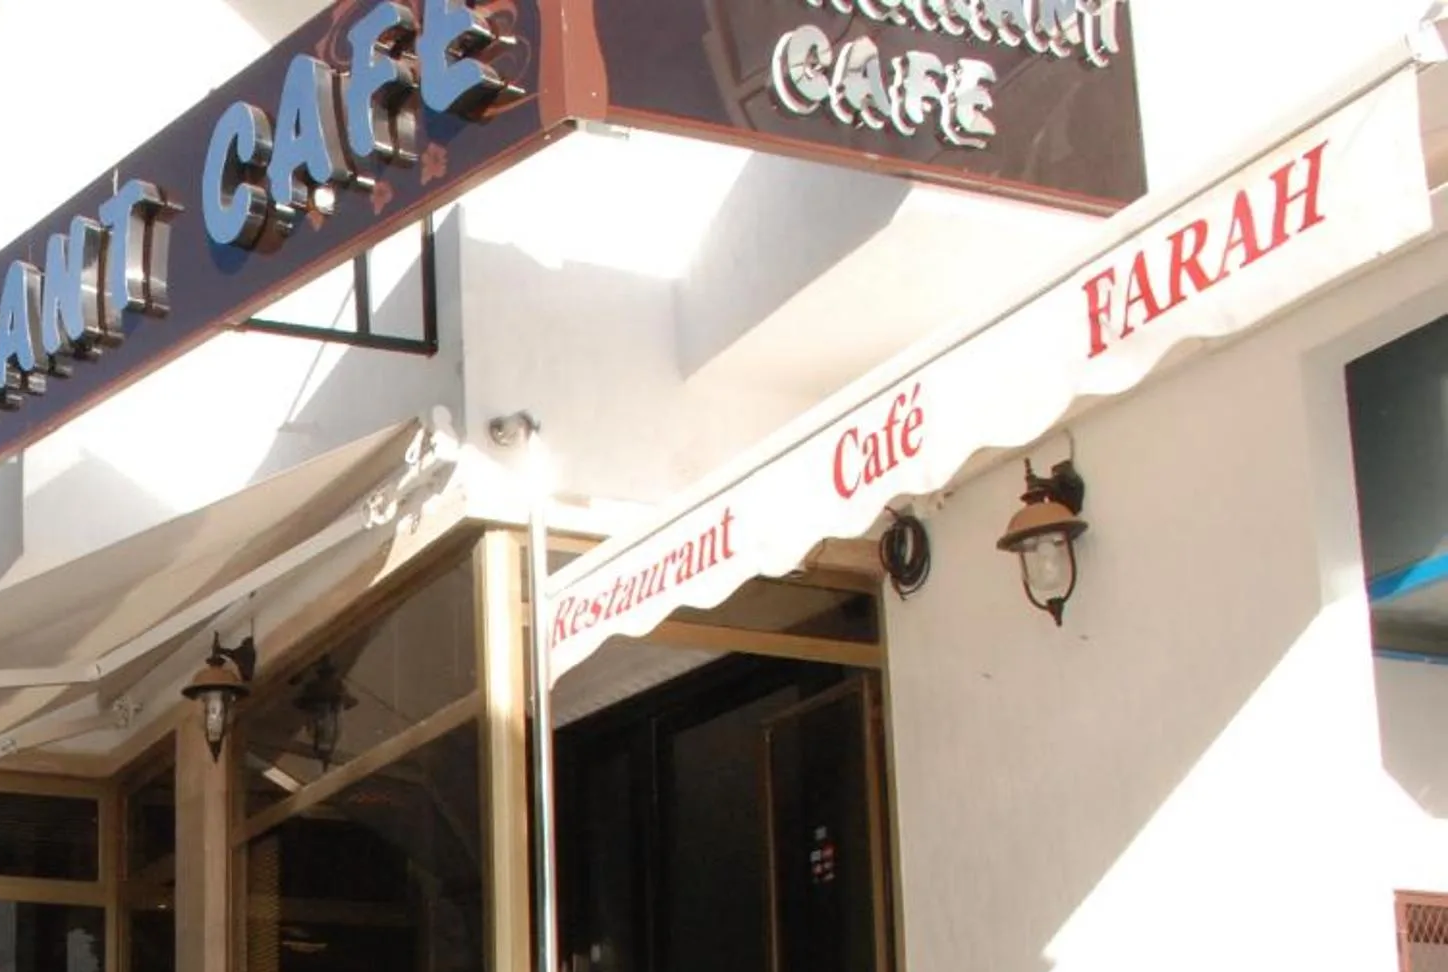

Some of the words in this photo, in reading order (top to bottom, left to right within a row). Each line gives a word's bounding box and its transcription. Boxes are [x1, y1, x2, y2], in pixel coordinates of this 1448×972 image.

[771, 24, 996, 148] CAFE
[550, 506, 735, 649] Restaurant
[833, 382, 925, 500] Café
[1082, 139, 1330, 359] FARAH
